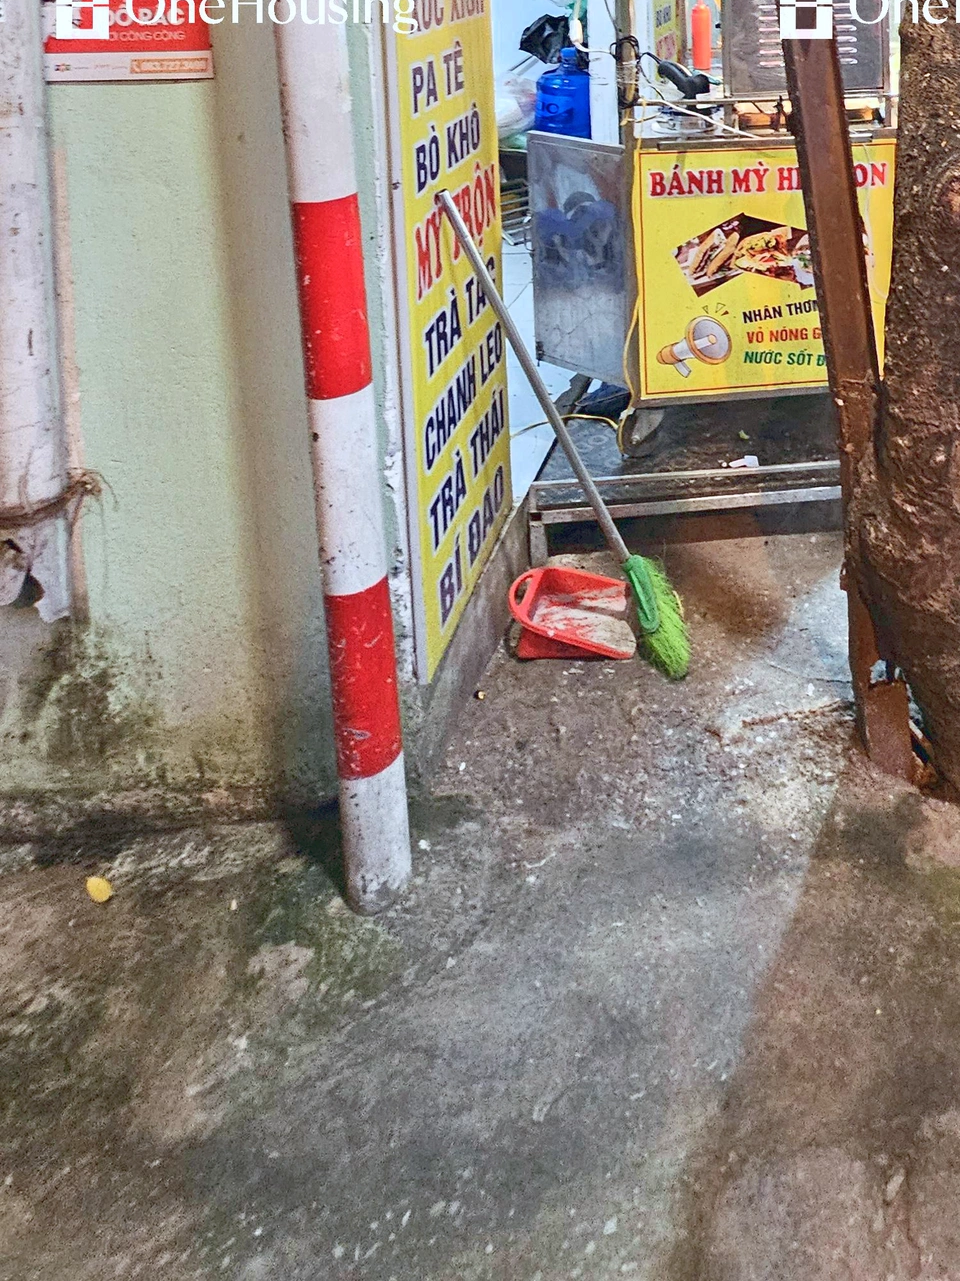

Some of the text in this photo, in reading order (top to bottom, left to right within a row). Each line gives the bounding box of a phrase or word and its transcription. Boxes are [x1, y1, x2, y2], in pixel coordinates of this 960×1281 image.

[412, 40, 465, 114] PA TÊ
[415, 102, 481, 194] BÒ KHÔ
[650, 165, 723, 197] BÁNH
[731, 161, 769, 193] MỲ
[424, 286, 462, 377] TRÀ
[742, 304, 783, 324] NHÂN
[424, 321, 503, 471] CHANH LEO
[743, 349, 783, 365] NƯỚC
[787, 348, 813, 366] SỐT
[429, 386, 505, 551] TRÀ THÁI
